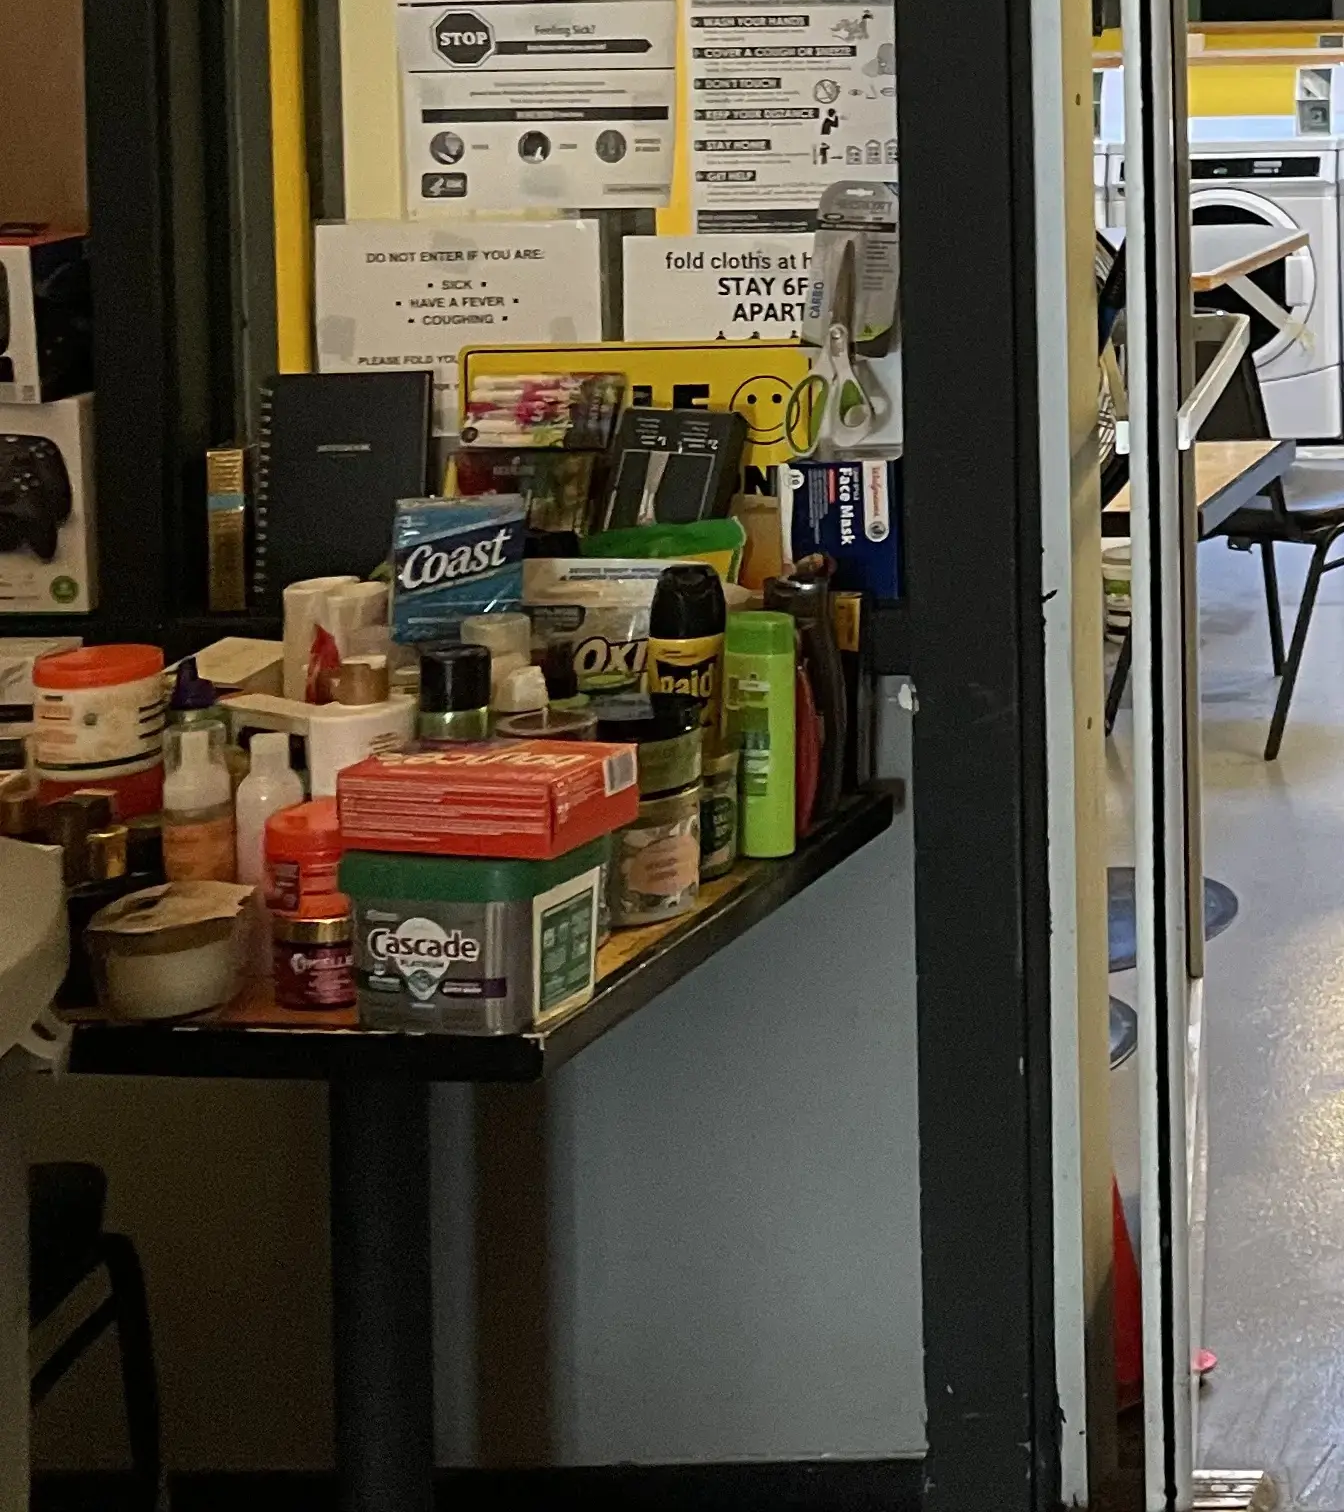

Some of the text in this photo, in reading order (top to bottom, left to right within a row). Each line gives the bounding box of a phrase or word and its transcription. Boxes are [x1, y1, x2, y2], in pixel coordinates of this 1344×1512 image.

[439, 30, 488, 47] STOP
[365, 252, 386, 263] DO
[389, 251, 416, 263] NOT
[420, 250, 464, 262] ENTER
[483, 249, 511, 260] YOU
[665, 251, 704, 270] fold
[778, 254, 796, 270] at
[441, 279, 473, 290] SICK
[718, 277, 776, 296] STAY
[410, 296, 505, 308] HAVE A FEVER
[422, 313, 494, 325] COUGHING
[732, 302, 807, 322] APART
[838, 466, 857, 546] Face Mask
[398, 528, 512, 589] Coast
[368, 928, 480, 961] Cascade
